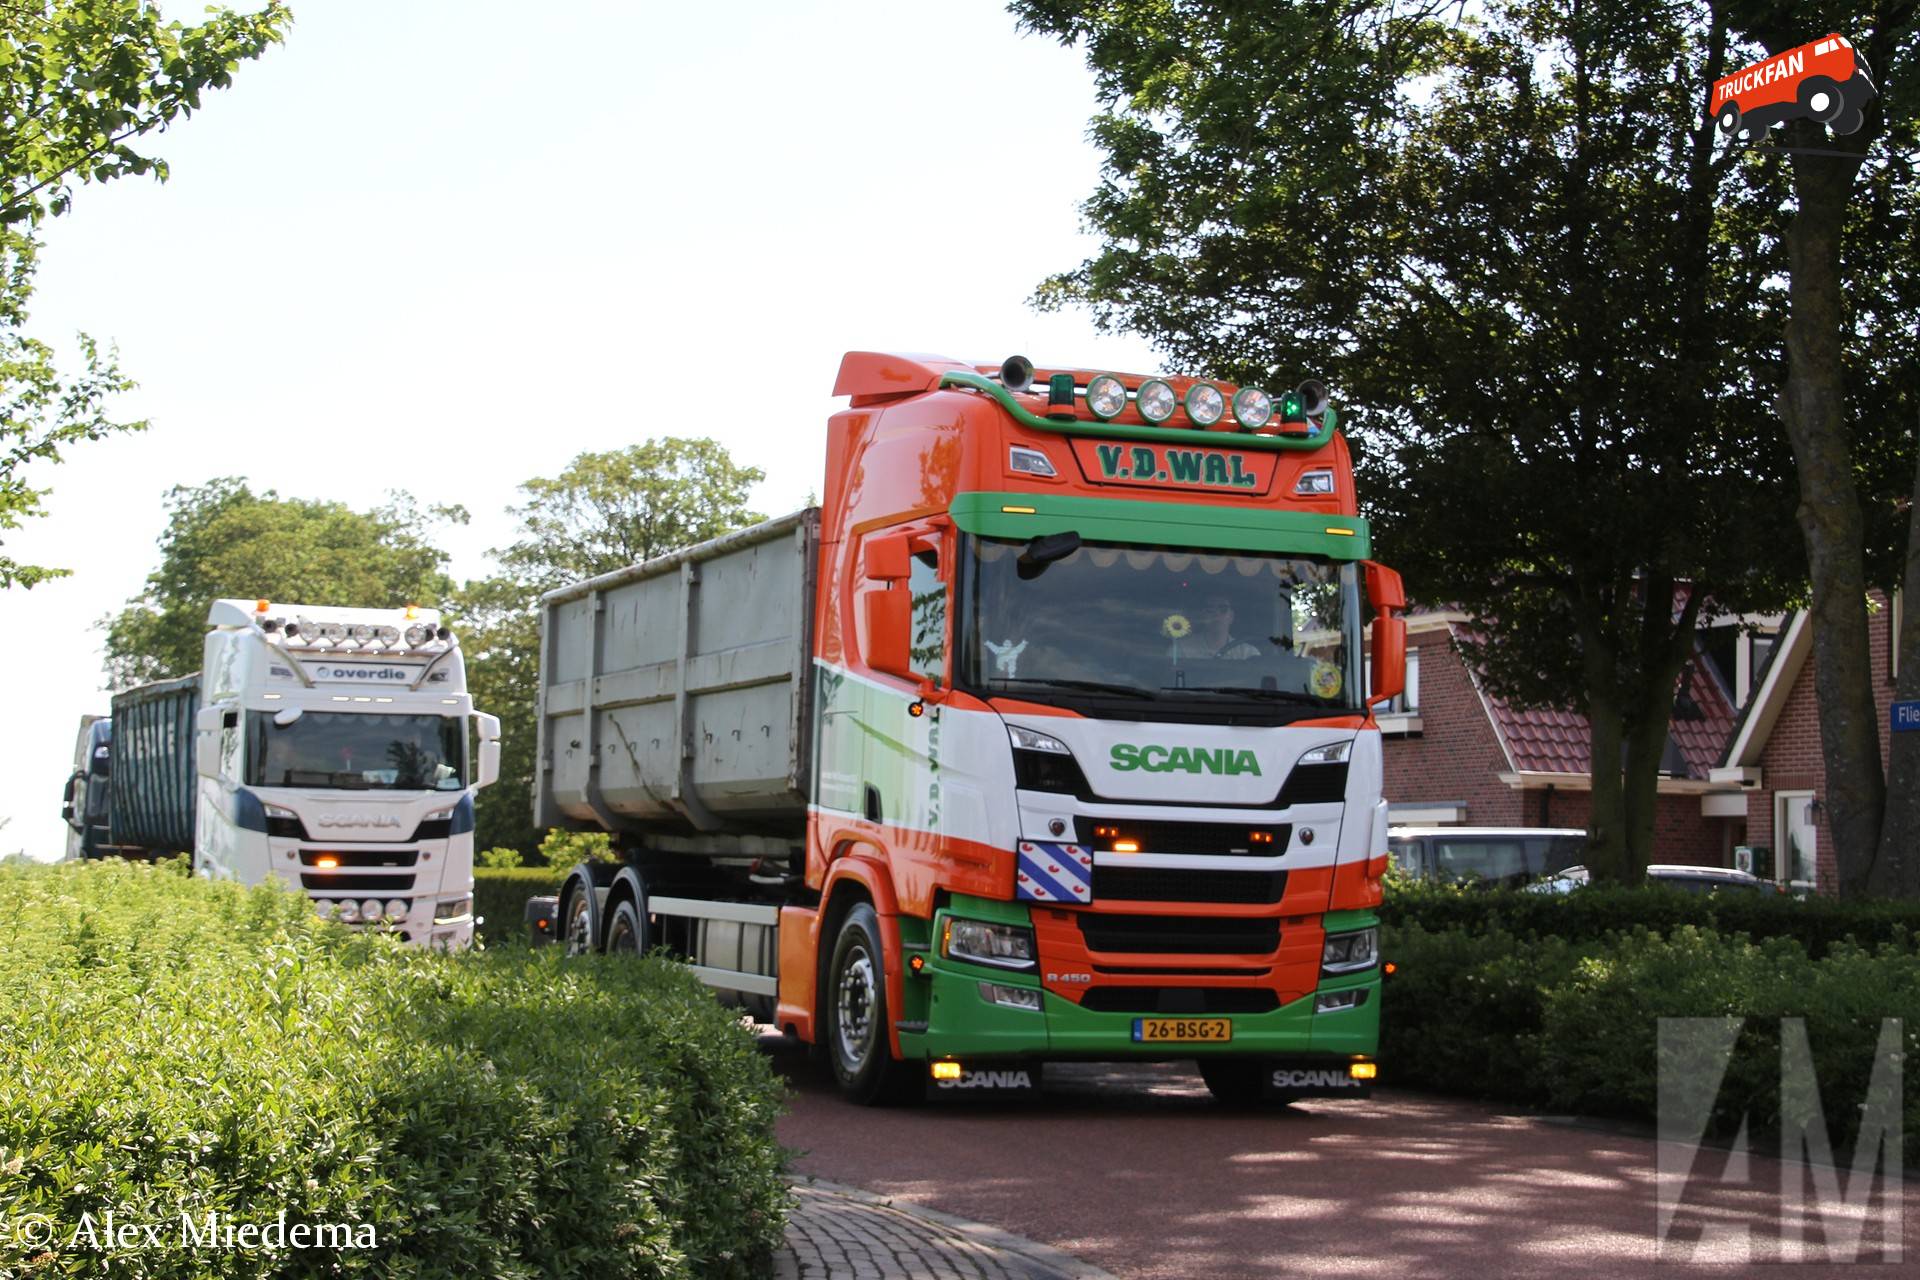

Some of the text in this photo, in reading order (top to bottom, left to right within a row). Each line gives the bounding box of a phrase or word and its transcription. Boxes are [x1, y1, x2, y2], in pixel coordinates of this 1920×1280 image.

[333, 668, 406, 680] overdie
[1898, 705, 1920, 723] Flie
[1110, 743, 1262, 776] SCANIA
[1047, 973, 1090, 983] R 450
[1148, 1022, 1225, 1038] 26-BSG-2
